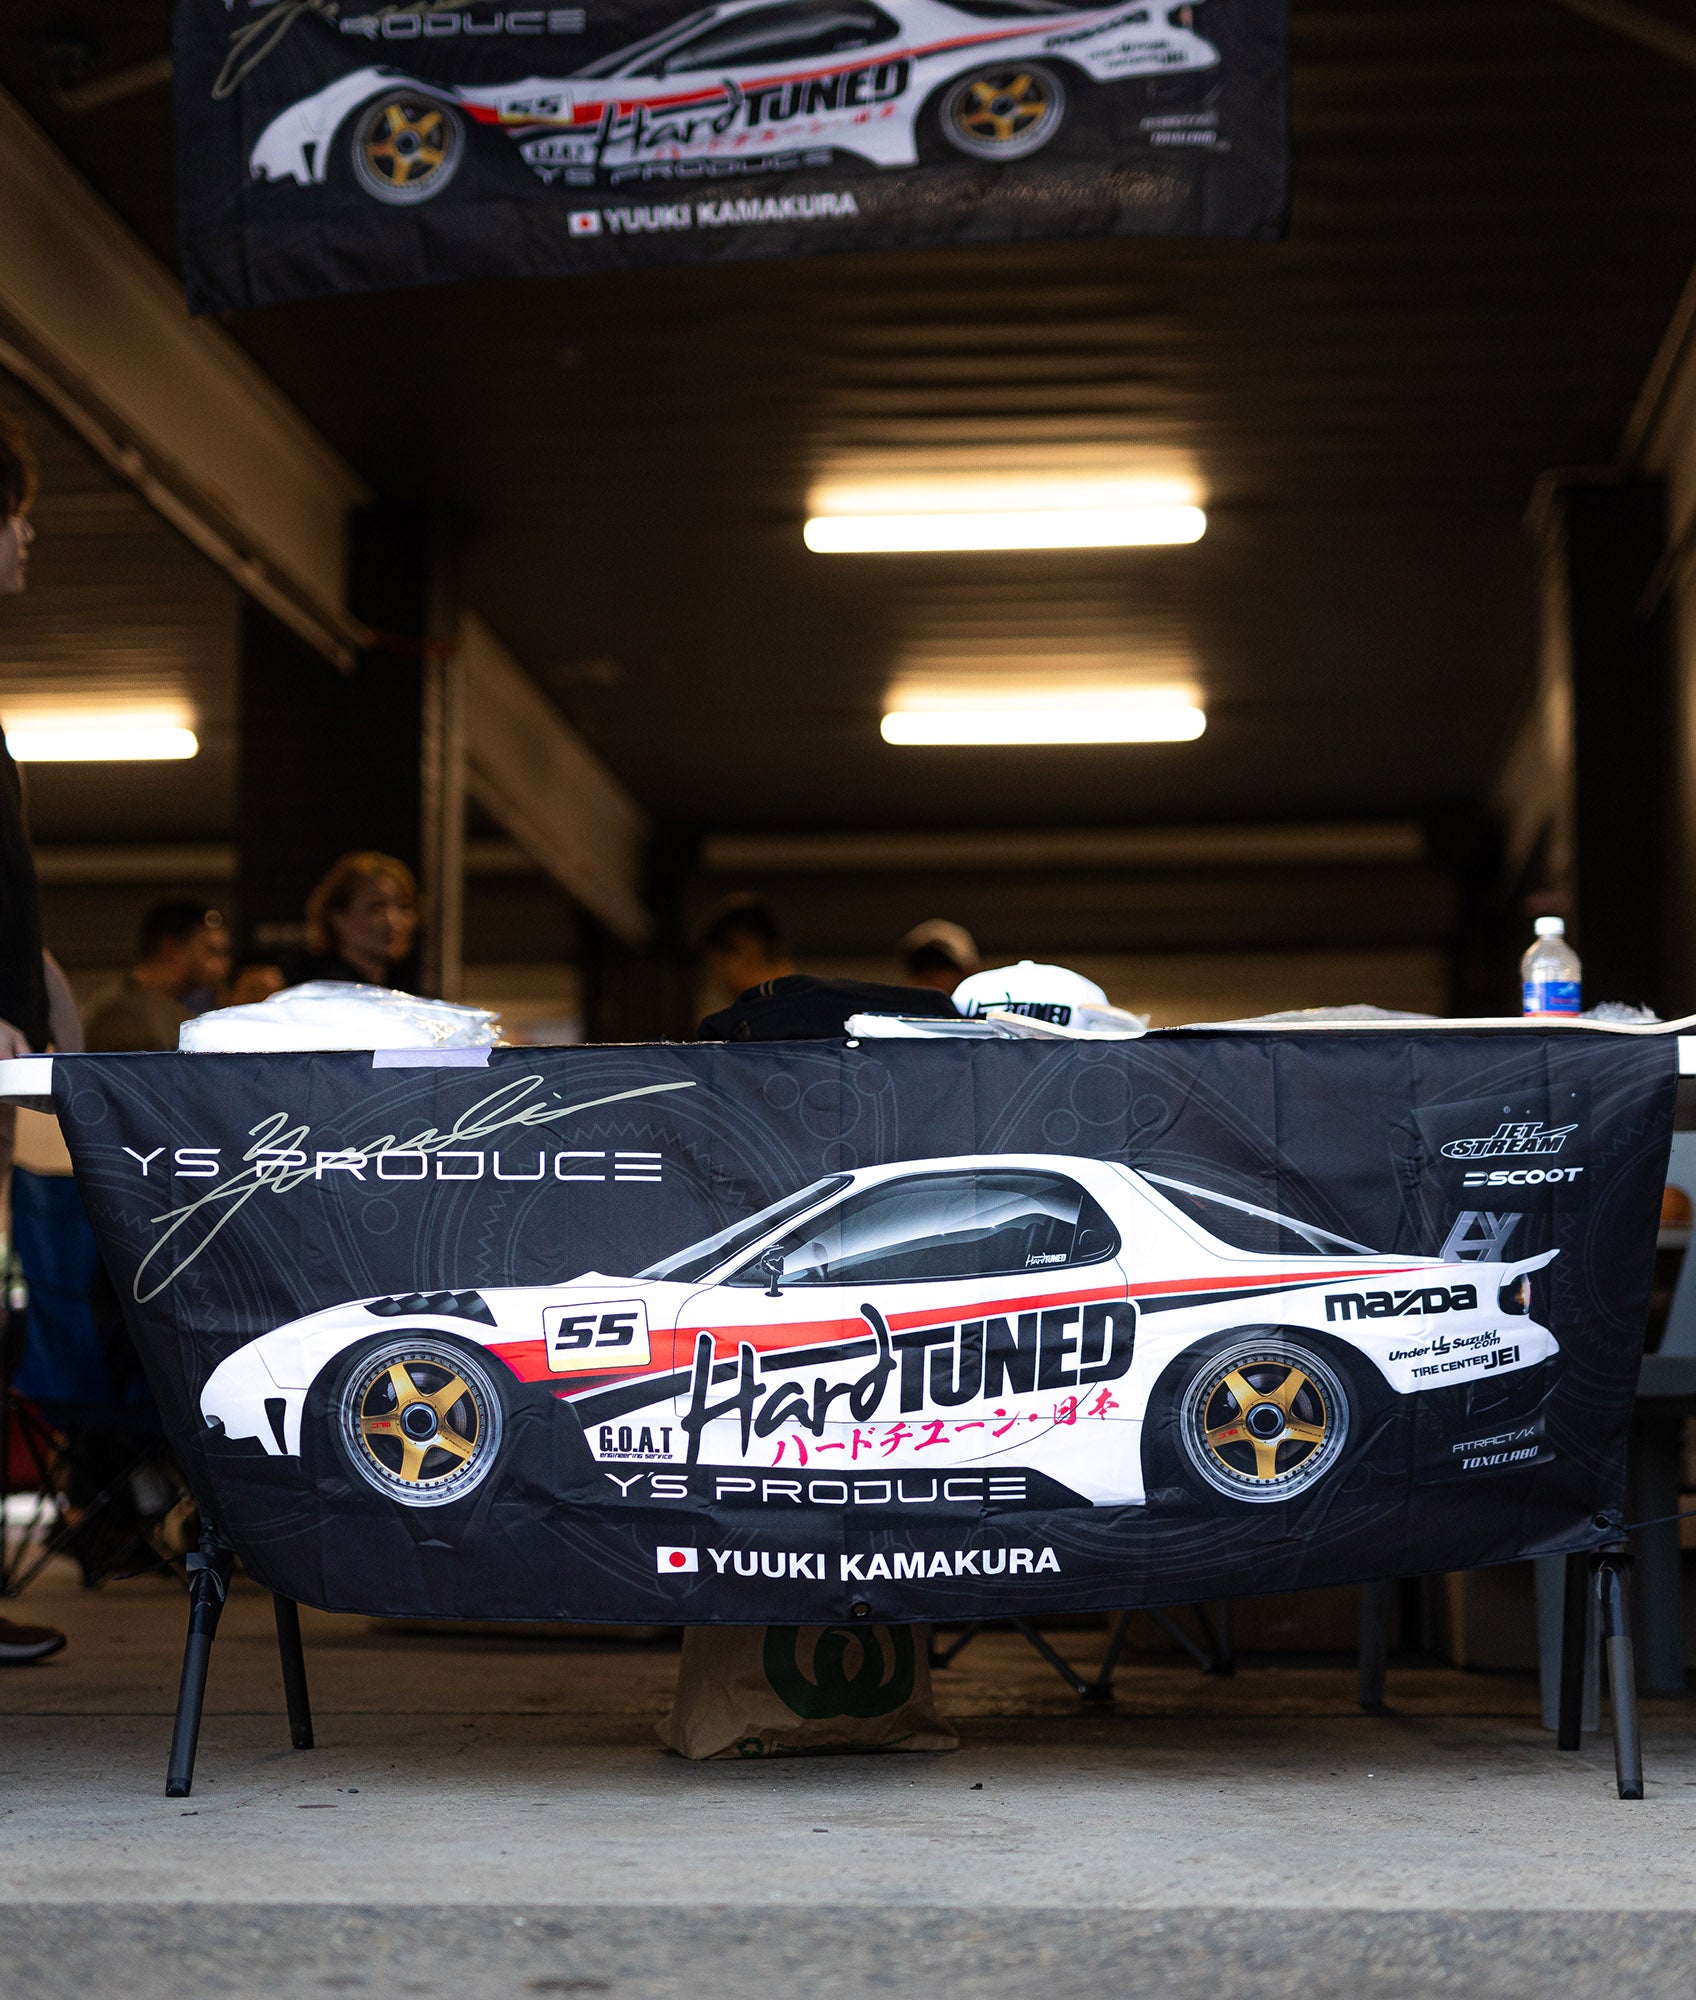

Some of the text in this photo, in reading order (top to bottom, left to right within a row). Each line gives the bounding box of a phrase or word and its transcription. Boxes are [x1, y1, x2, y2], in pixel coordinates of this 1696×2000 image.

[602, 191, 860, 234] YUUKI KAMAKURA
[1450, 1135, 1567, 1157] STREAM
[1492, 1122, 1544, 1141] JET
[256, 1149, 663, 1182] PRODUCE
[556, 1312, 638, 1351] 55
[1388, 1347, 1431, 1362] Under
[1452, 1329, 1498, 1349] Suzuki
[1411, 1345, 1520, 1378] TIRE CENTER JEI
[599, 1425, 673, 1453] G.O.A.T
[599, 1452, 643, 1460] engineering
[716, 1476, 1026, 1505] PRODUCE
[707, 1547, 1061, 1582] YUUKI KAMAKURA
